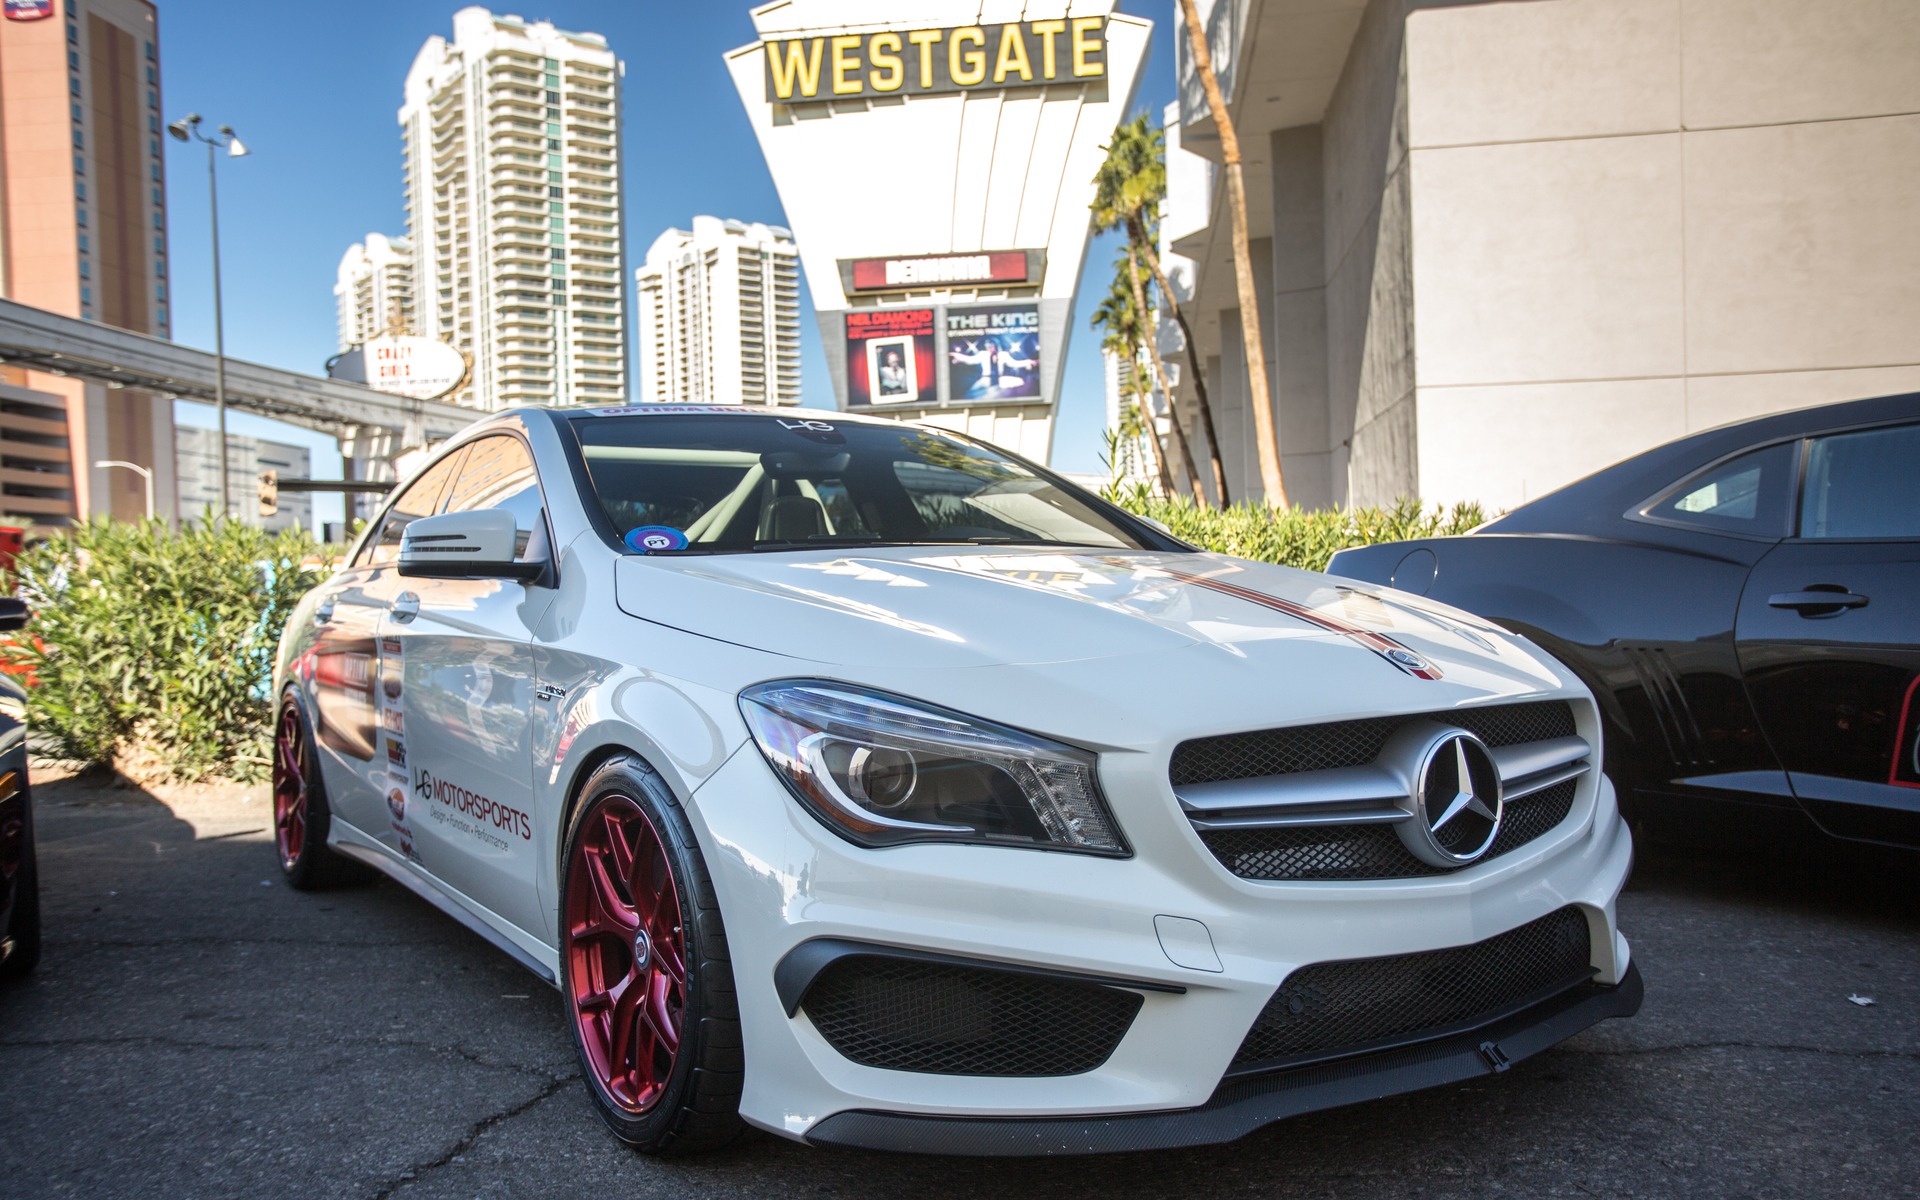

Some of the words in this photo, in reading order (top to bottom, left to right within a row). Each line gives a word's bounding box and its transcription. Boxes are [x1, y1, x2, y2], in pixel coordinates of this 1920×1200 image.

[766, 17, 1104, 98] WESTGATE
[872, 309, 933, 325] DIAMOND
[947, 314, 988, 329] THE
[991, 312, 1038, 327] KING
[377, 347, 412, 360] CRAZY
[433, 776, 531, 841] MOTORSPORTS
[430, 805, 447, 824] Design
[449, 814, 471, 835] Function
[474, 825, 509, 852] Performance
